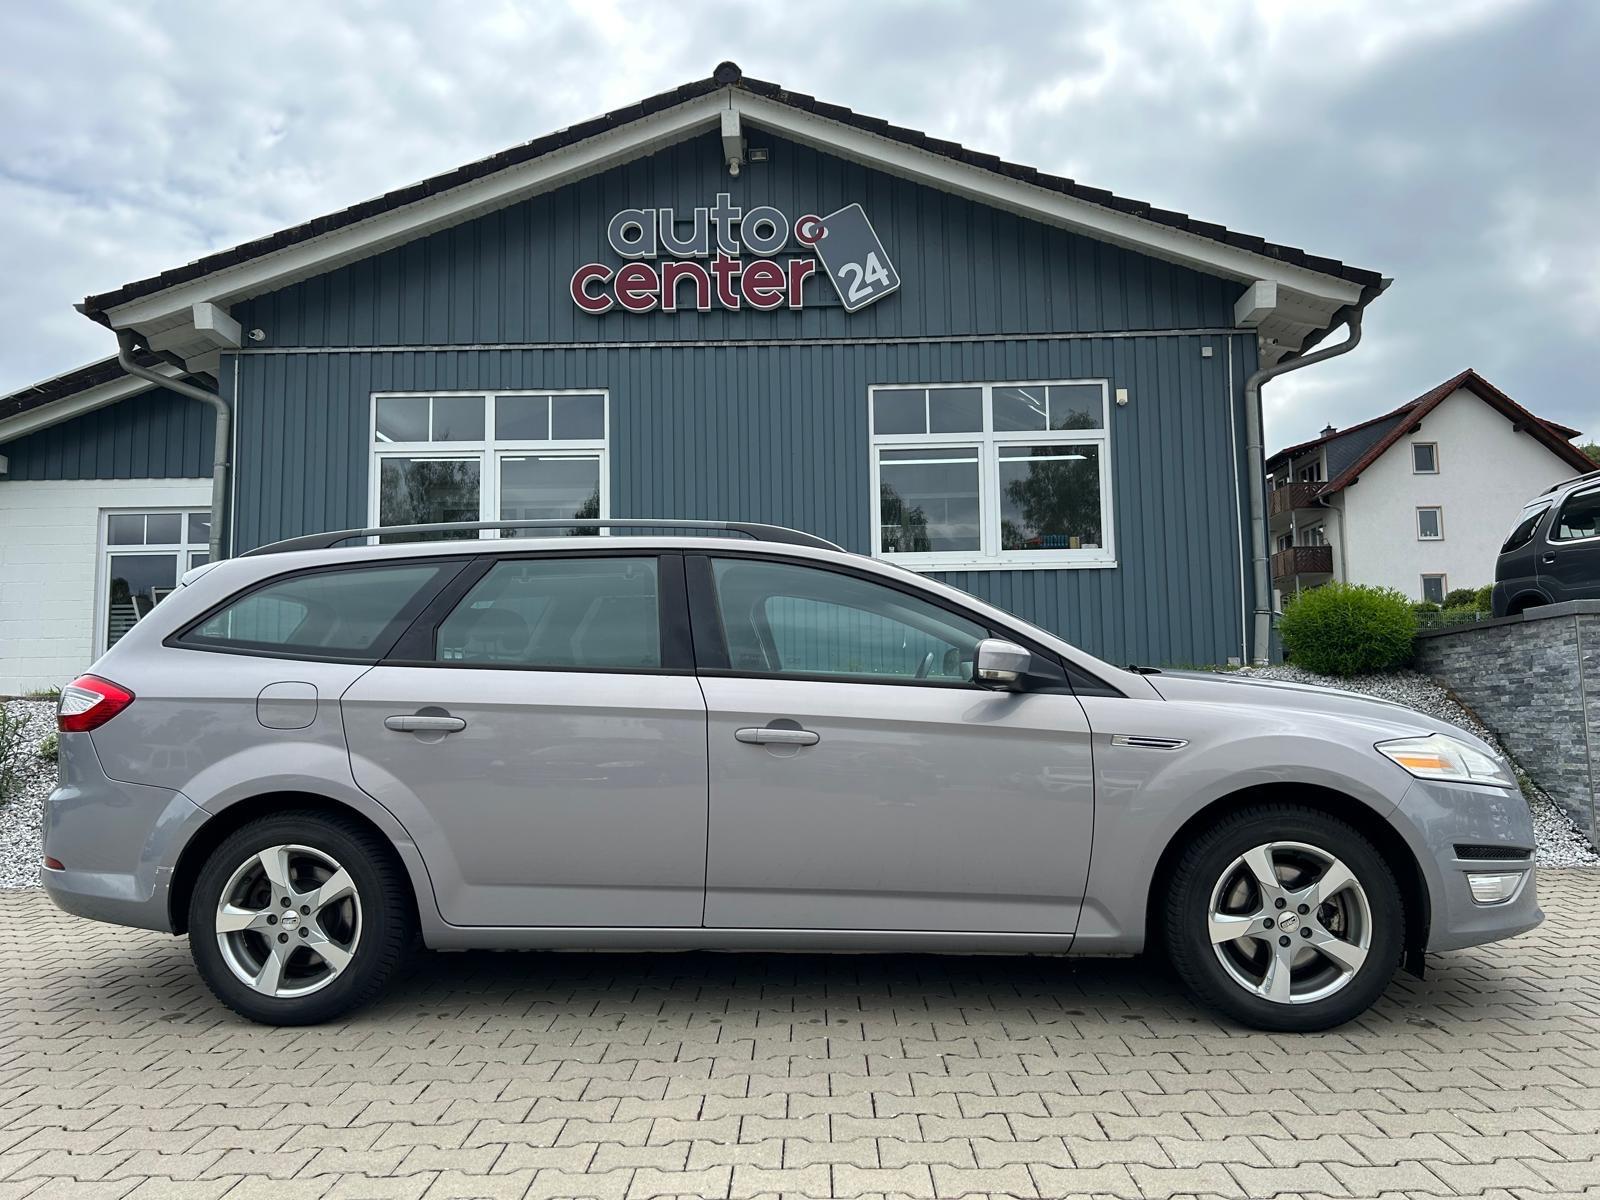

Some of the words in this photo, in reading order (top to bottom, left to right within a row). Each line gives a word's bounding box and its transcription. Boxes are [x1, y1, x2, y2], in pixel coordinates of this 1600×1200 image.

[607, 192, 789, 259] auto
[570, 249, 816, 313] center
[837, 251, 889, 303] 24
